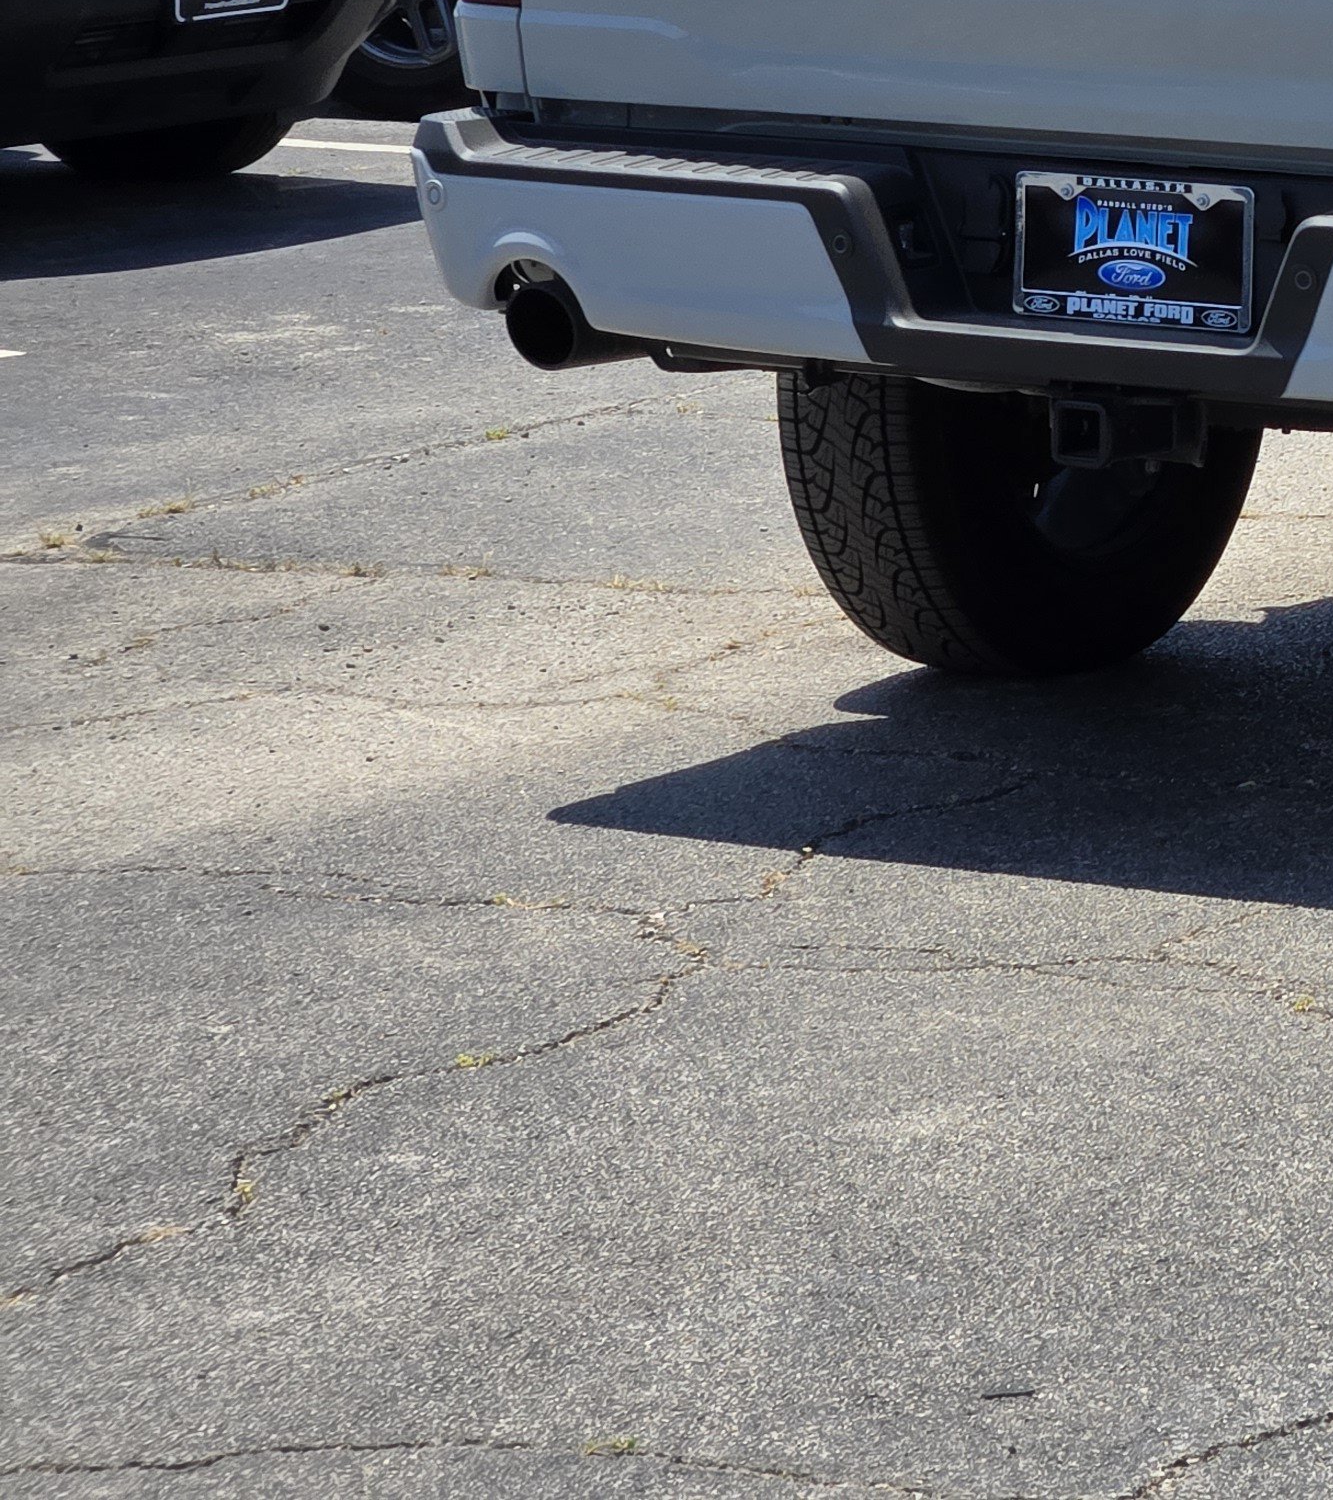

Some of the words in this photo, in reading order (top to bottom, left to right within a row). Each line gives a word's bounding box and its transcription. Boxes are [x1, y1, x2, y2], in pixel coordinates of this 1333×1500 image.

[1074, 195, 1194, 259] PLANET
[1078, 248, 1119, 264] DALLAS
[1123, 248, 1152, 259] LOVE
[1155, 253, 1187, 272] FIELD
[1111, 263, 1152, 287] Ford
[1066, 296, 1139, 316] PLANET
[1143, 302, 1194, 325] FORD
